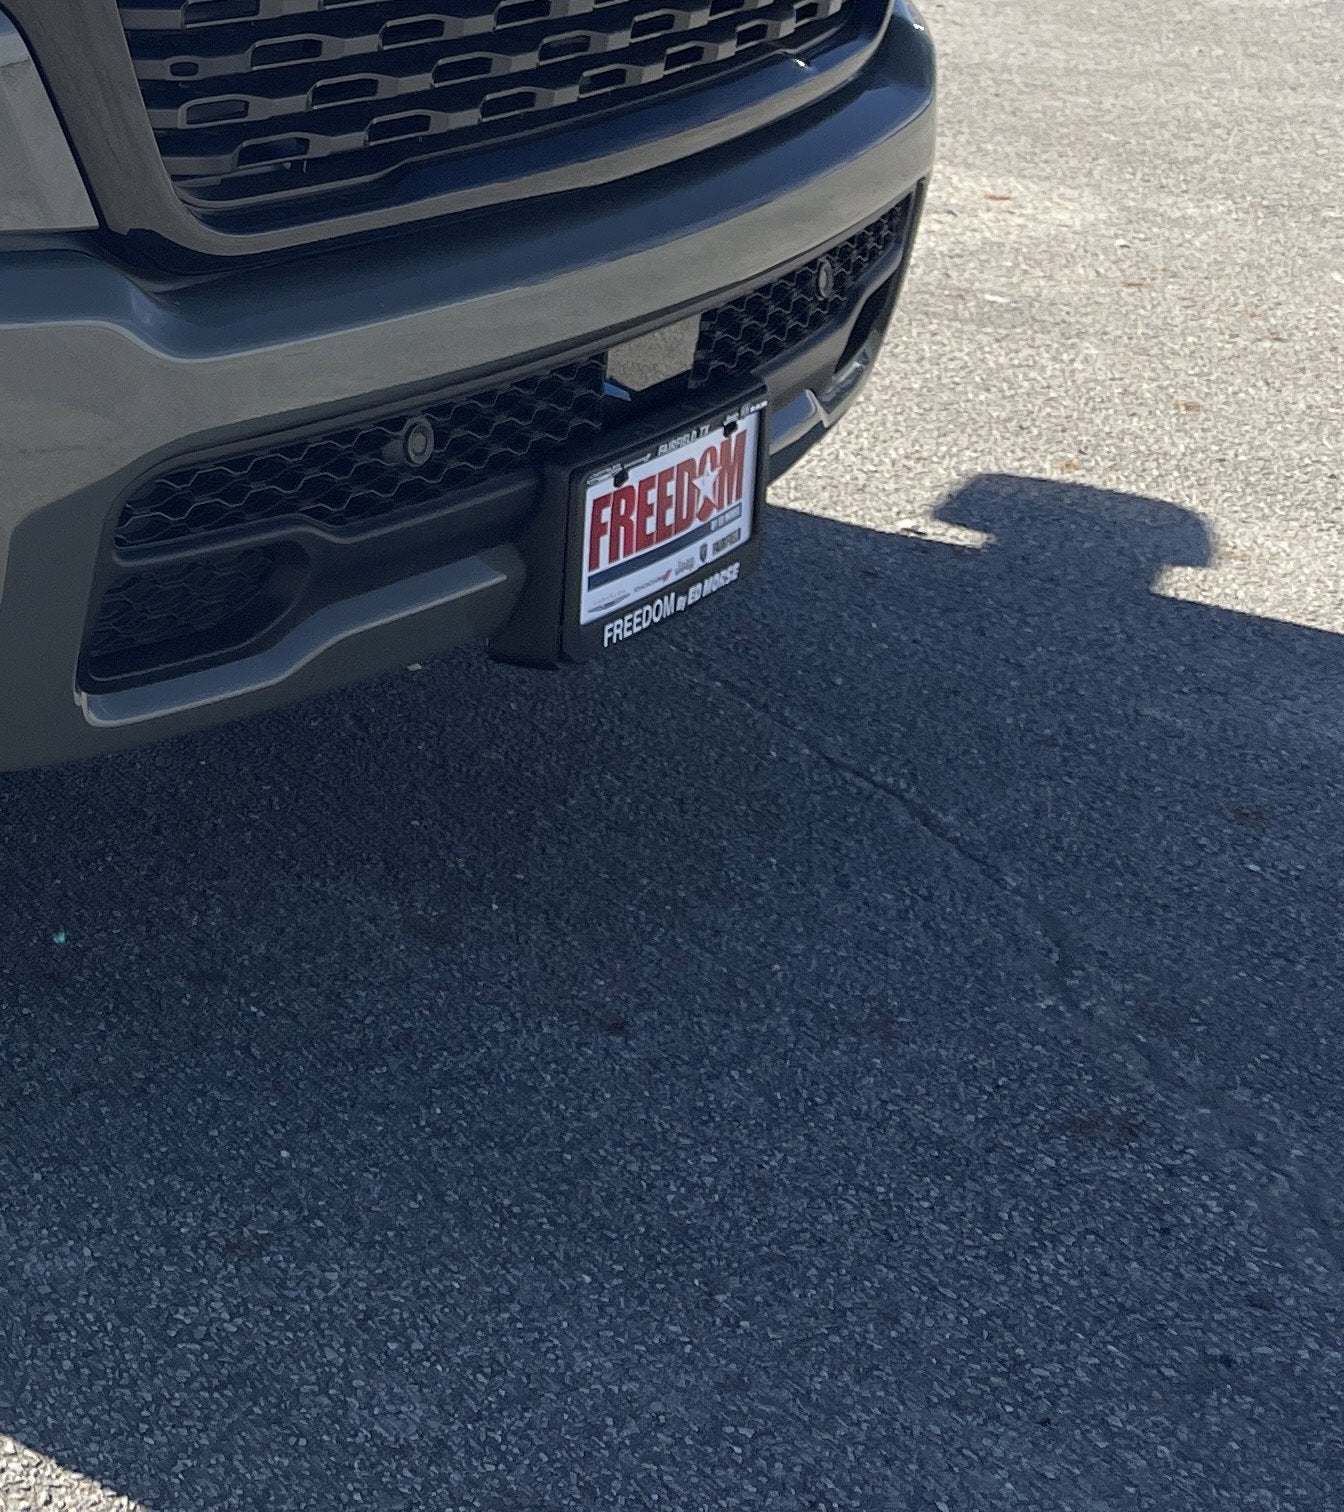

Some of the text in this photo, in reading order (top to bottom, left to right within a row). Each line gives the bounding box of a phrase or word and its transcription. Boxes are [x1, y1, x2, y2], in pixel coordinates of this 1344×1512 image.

[589, 430, 747, 572] FREEDOM
[603, 591, 676, 649] FREEDOM
[687, 580, 703, 606] ED
[703, 561, 740, 597] MORSE
